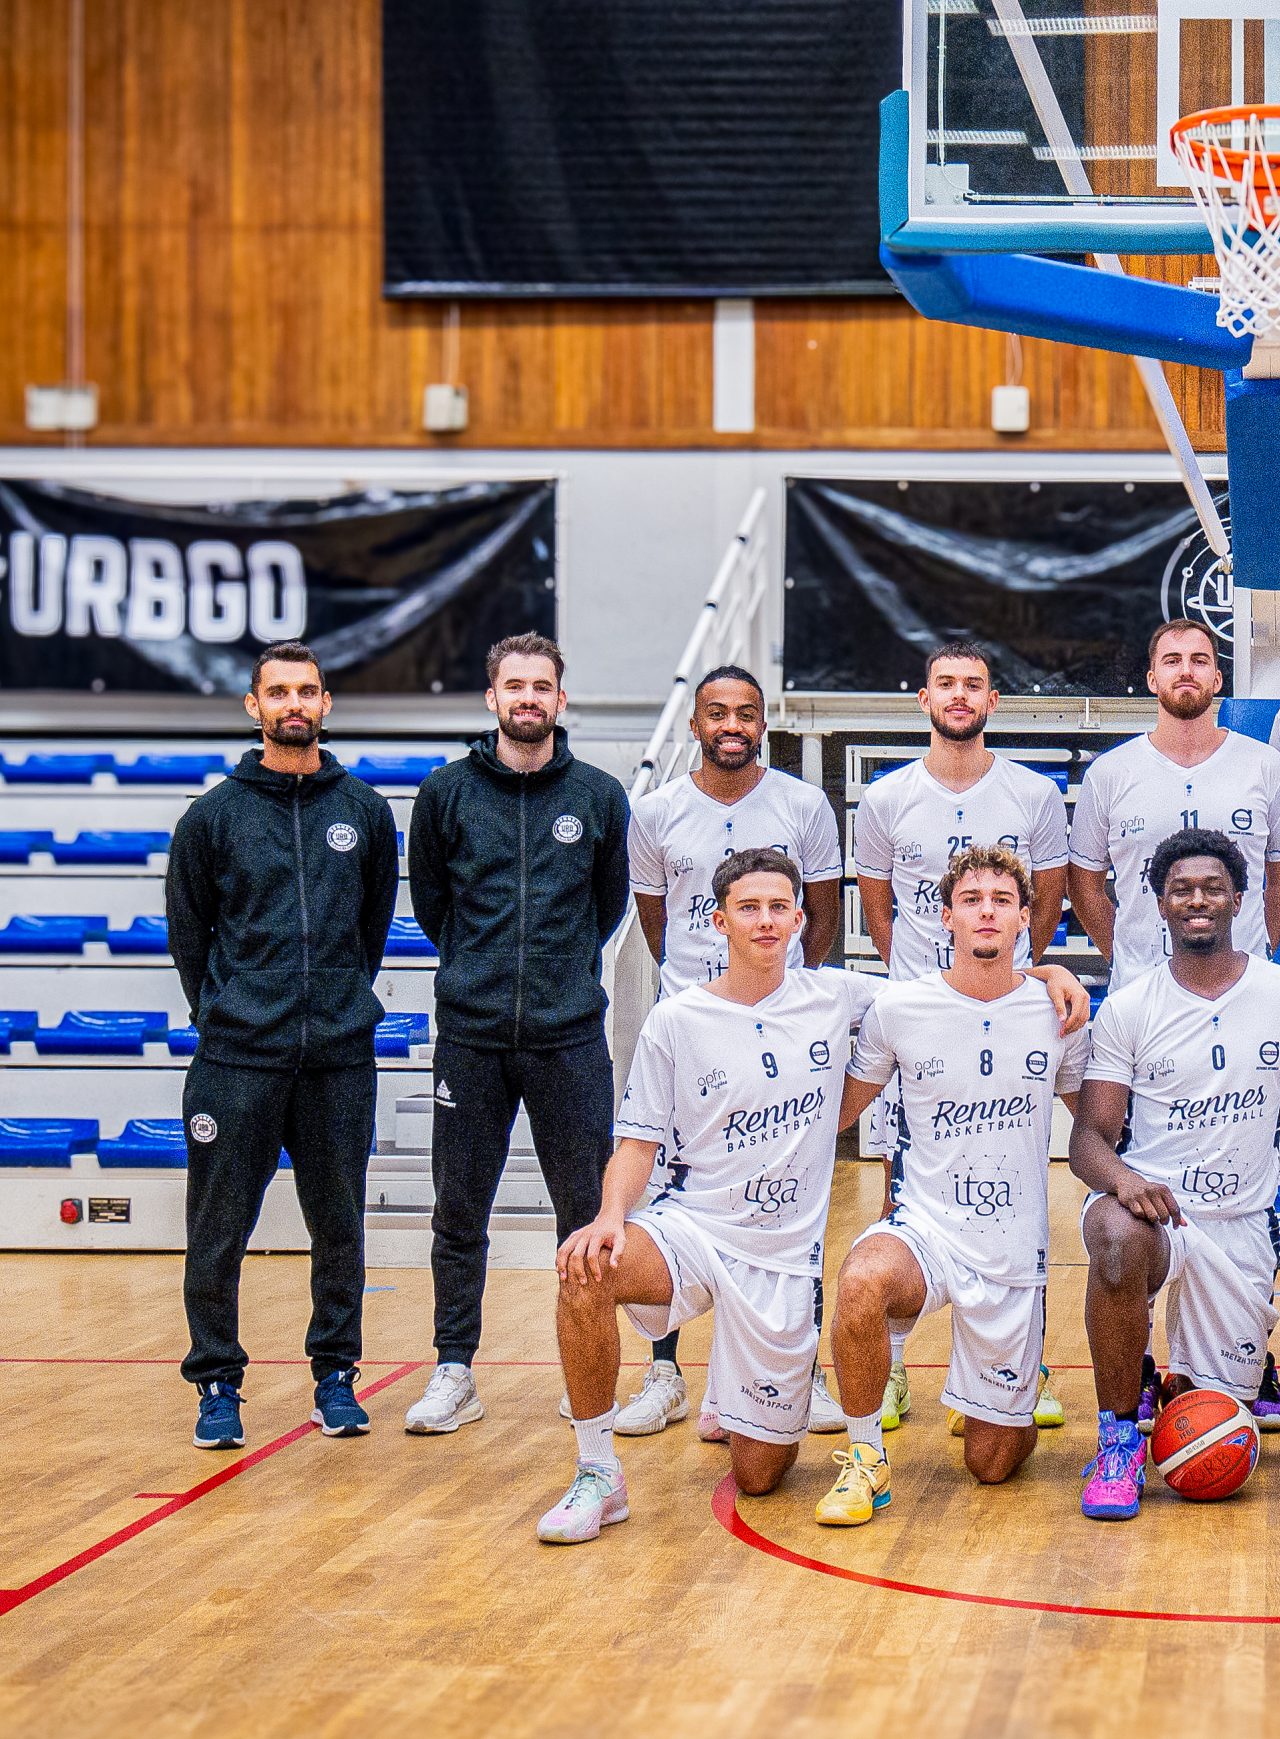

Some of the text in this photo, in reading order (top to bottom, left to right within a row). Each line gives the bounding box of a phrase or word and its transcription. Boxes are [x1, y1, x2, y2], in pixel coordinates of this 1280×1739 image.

[0, 531, 307, 643] URBGO
[1180, 809, 1198, 829] 11
[935, 942, 954, 969] it
[762, 1052, 778, 1079] 9
[980, 1049, 993, 1076] 8
[723, 1086, 826, 1140] Rennes
[931, 1093, 1037, 1128] Rennes
[1167, 1109, 1264, 1131] BASKETBALL
[1169, 1085, 1267, 1120] Rennes
[934, 1118, 1032, 1140] BASKETBALL
[744, 1174, 799, 1213] itga
[954, 1173, 1013, 1216] itga
[1182, 1165, 1239, 1202] itga
